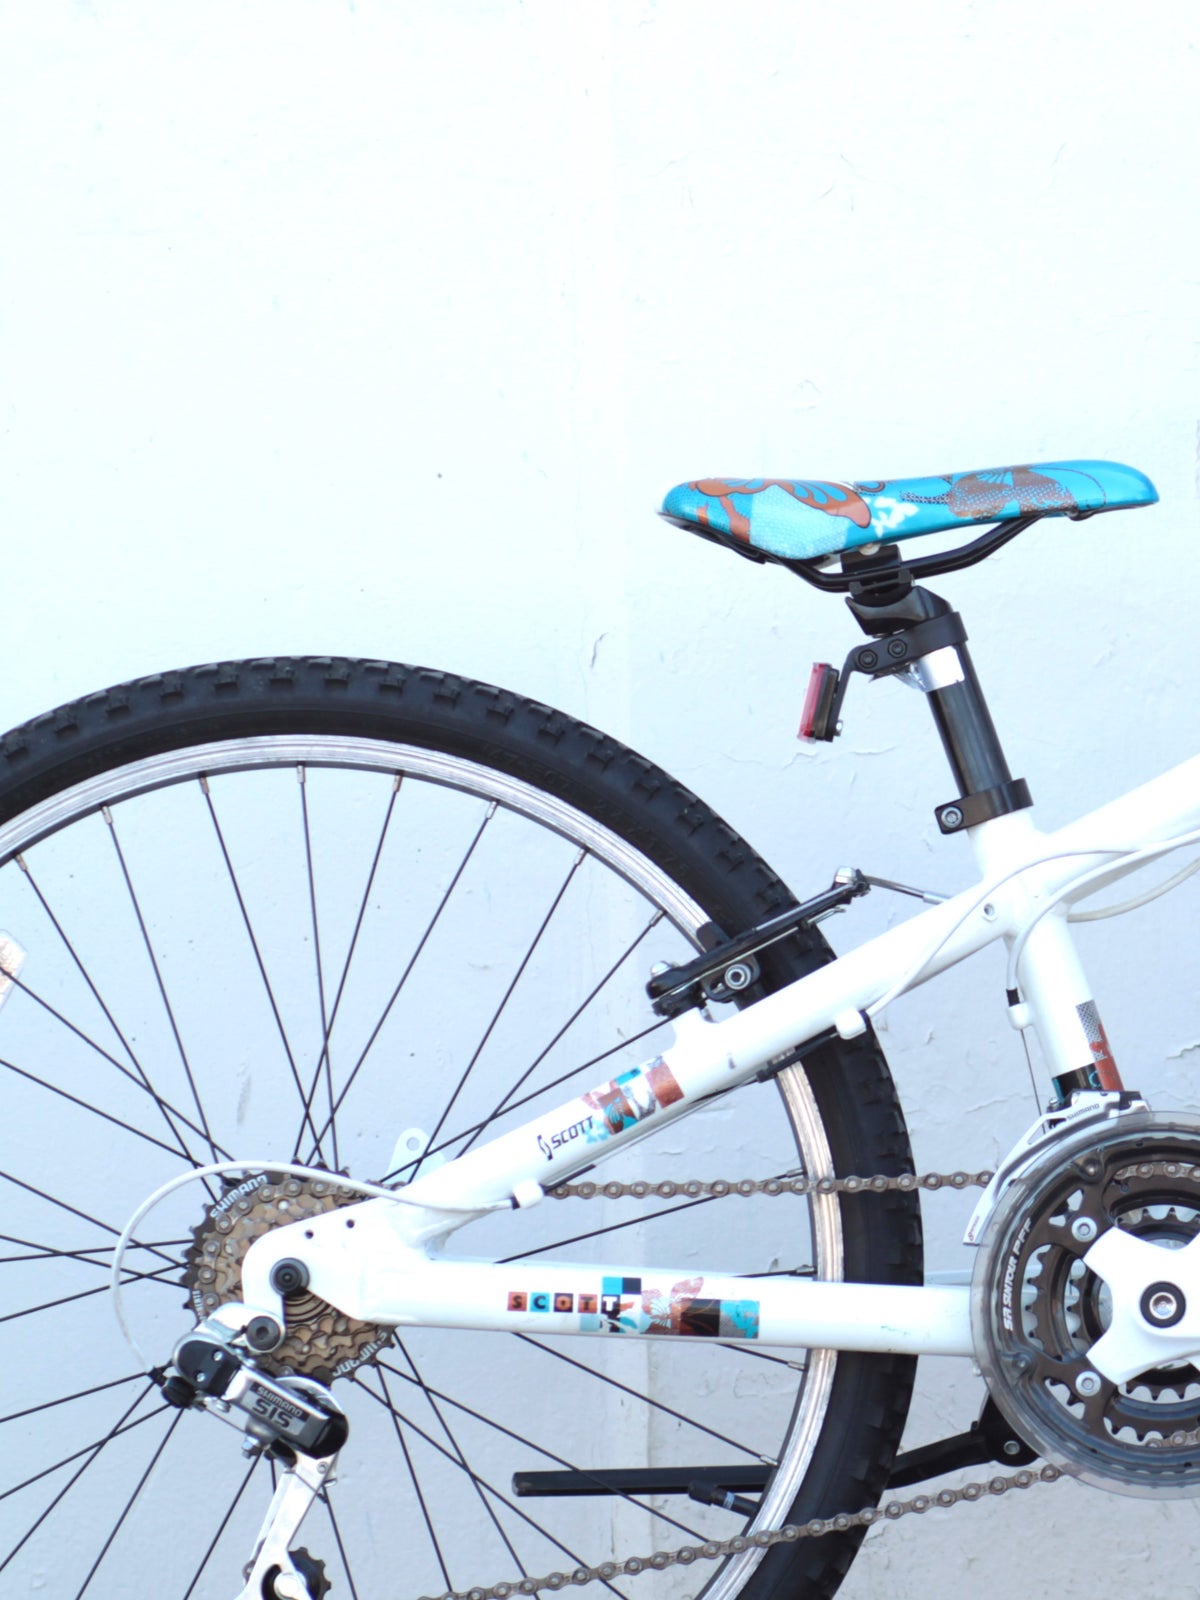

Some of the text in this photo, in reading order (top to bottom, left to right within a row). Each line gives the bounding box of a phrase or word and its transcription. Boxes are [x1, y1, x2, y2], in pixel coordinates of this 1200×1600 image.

[550, 1115, 594, 1150] SCOTT
[209, 1174, 268, 1219] SHIMANO
[1013, 1218, 1033, 1255] PFF
[510, 1293, 618, 1312] SCOTT
[252, 1396, 295, 1429] SIS
[256, 1385, 303, 1417] SHIMANO
